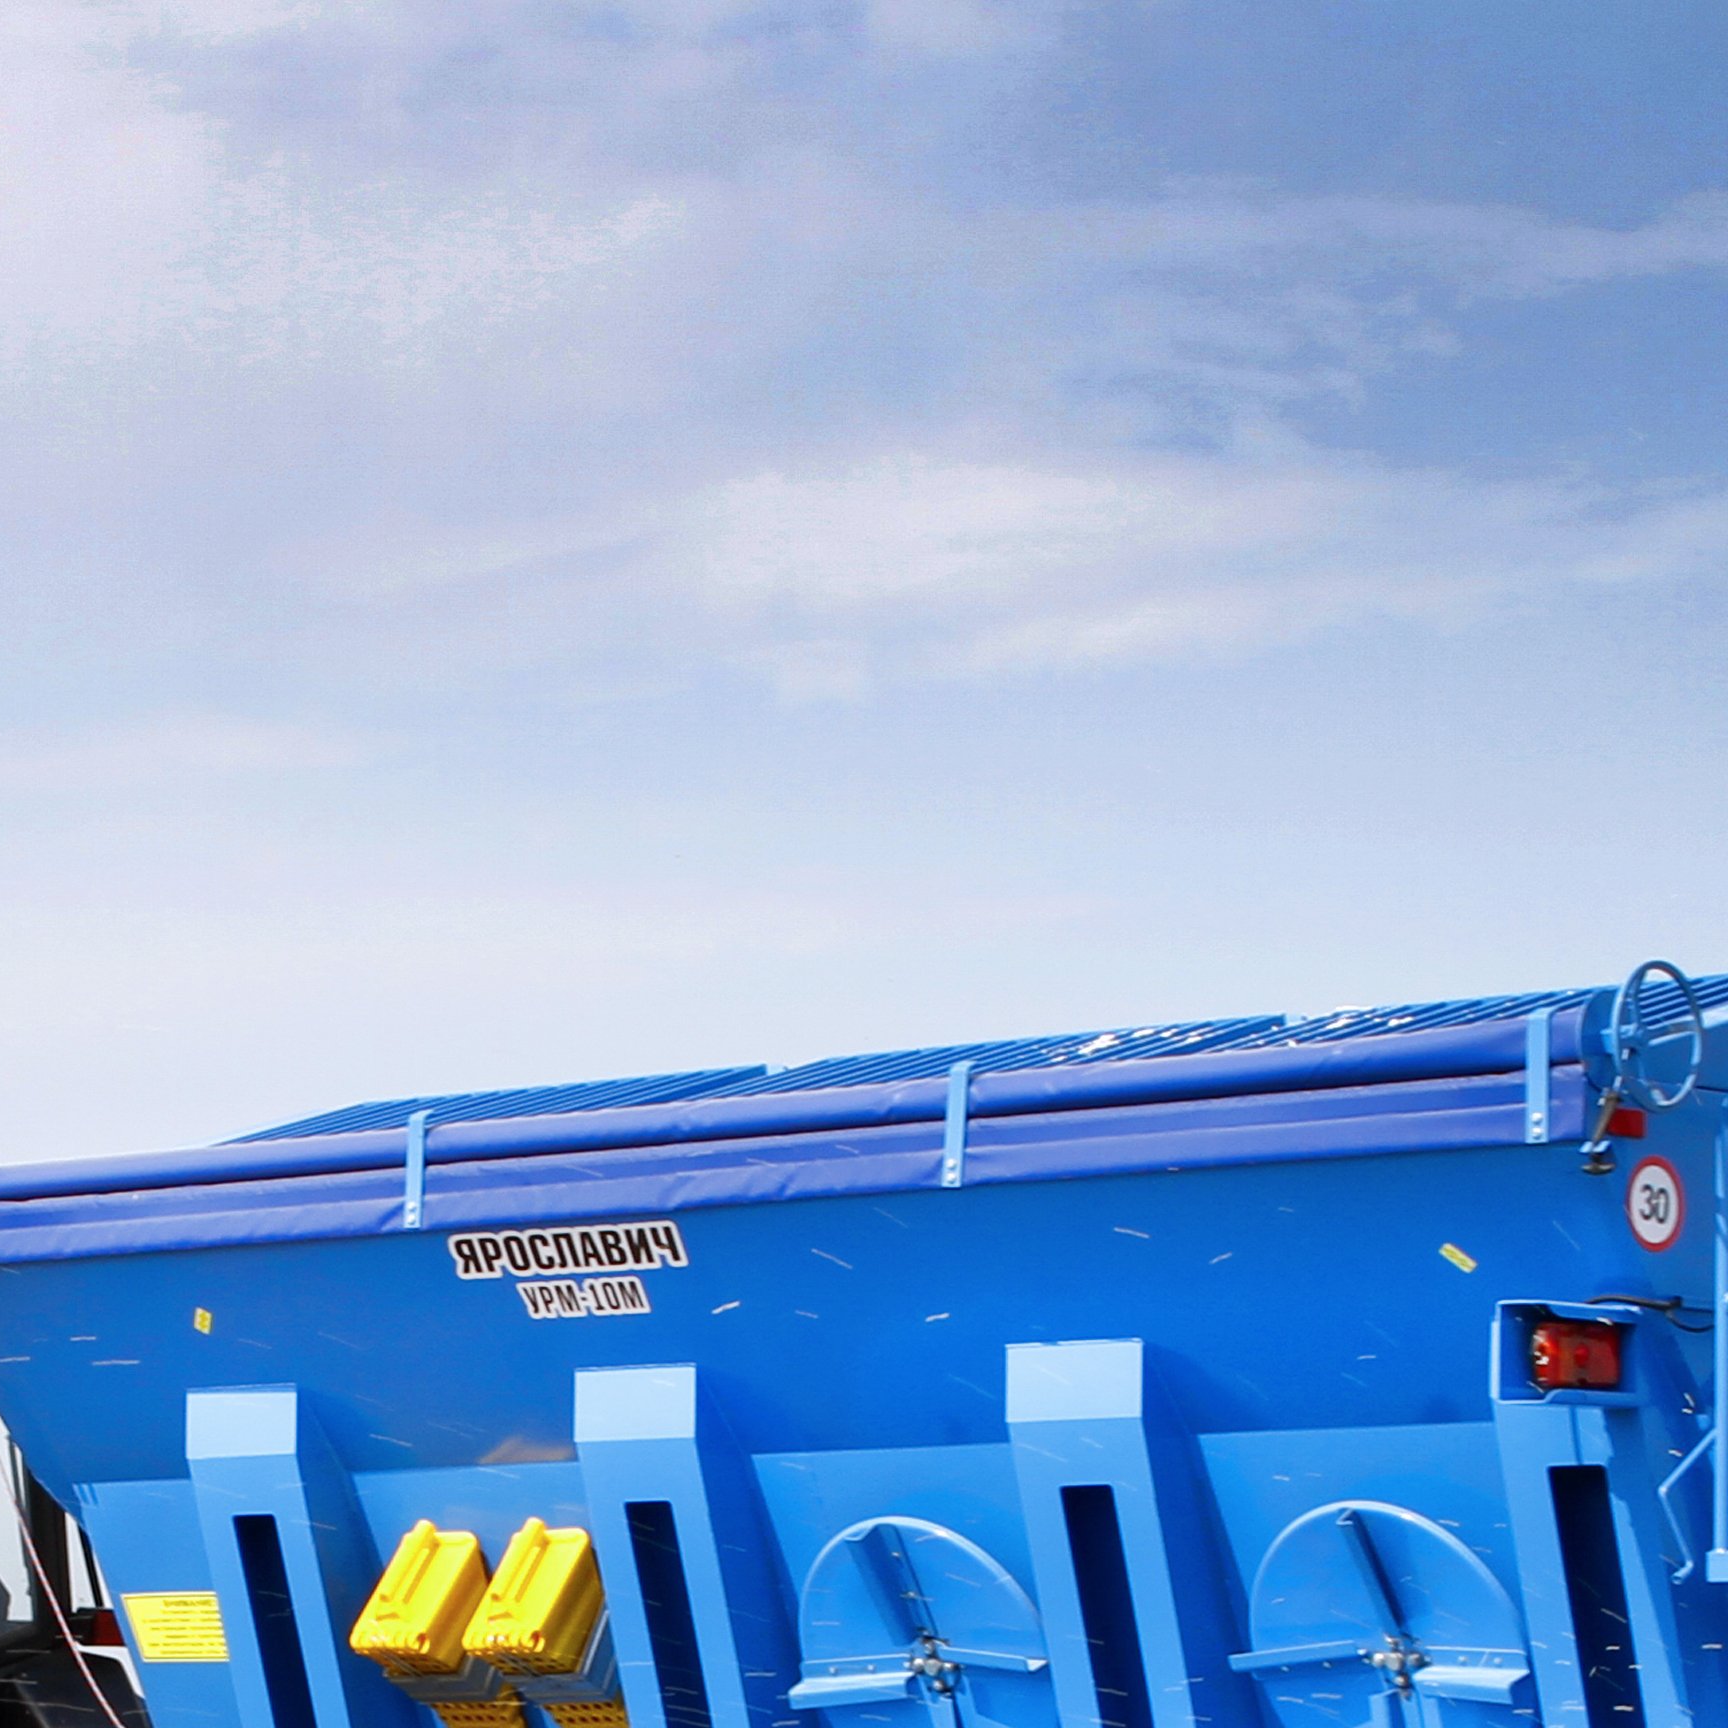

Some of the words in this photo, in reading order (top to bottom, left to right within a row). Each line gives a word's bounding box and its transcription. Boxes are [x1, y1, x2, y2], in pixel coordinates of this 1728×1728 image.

[1639, 1184, 1669, 1224] 30
[454, 1226, 681, 1274] ЯРОСЛАВИЧ
[522, 1281, 645, 1314] УРМ-10М
